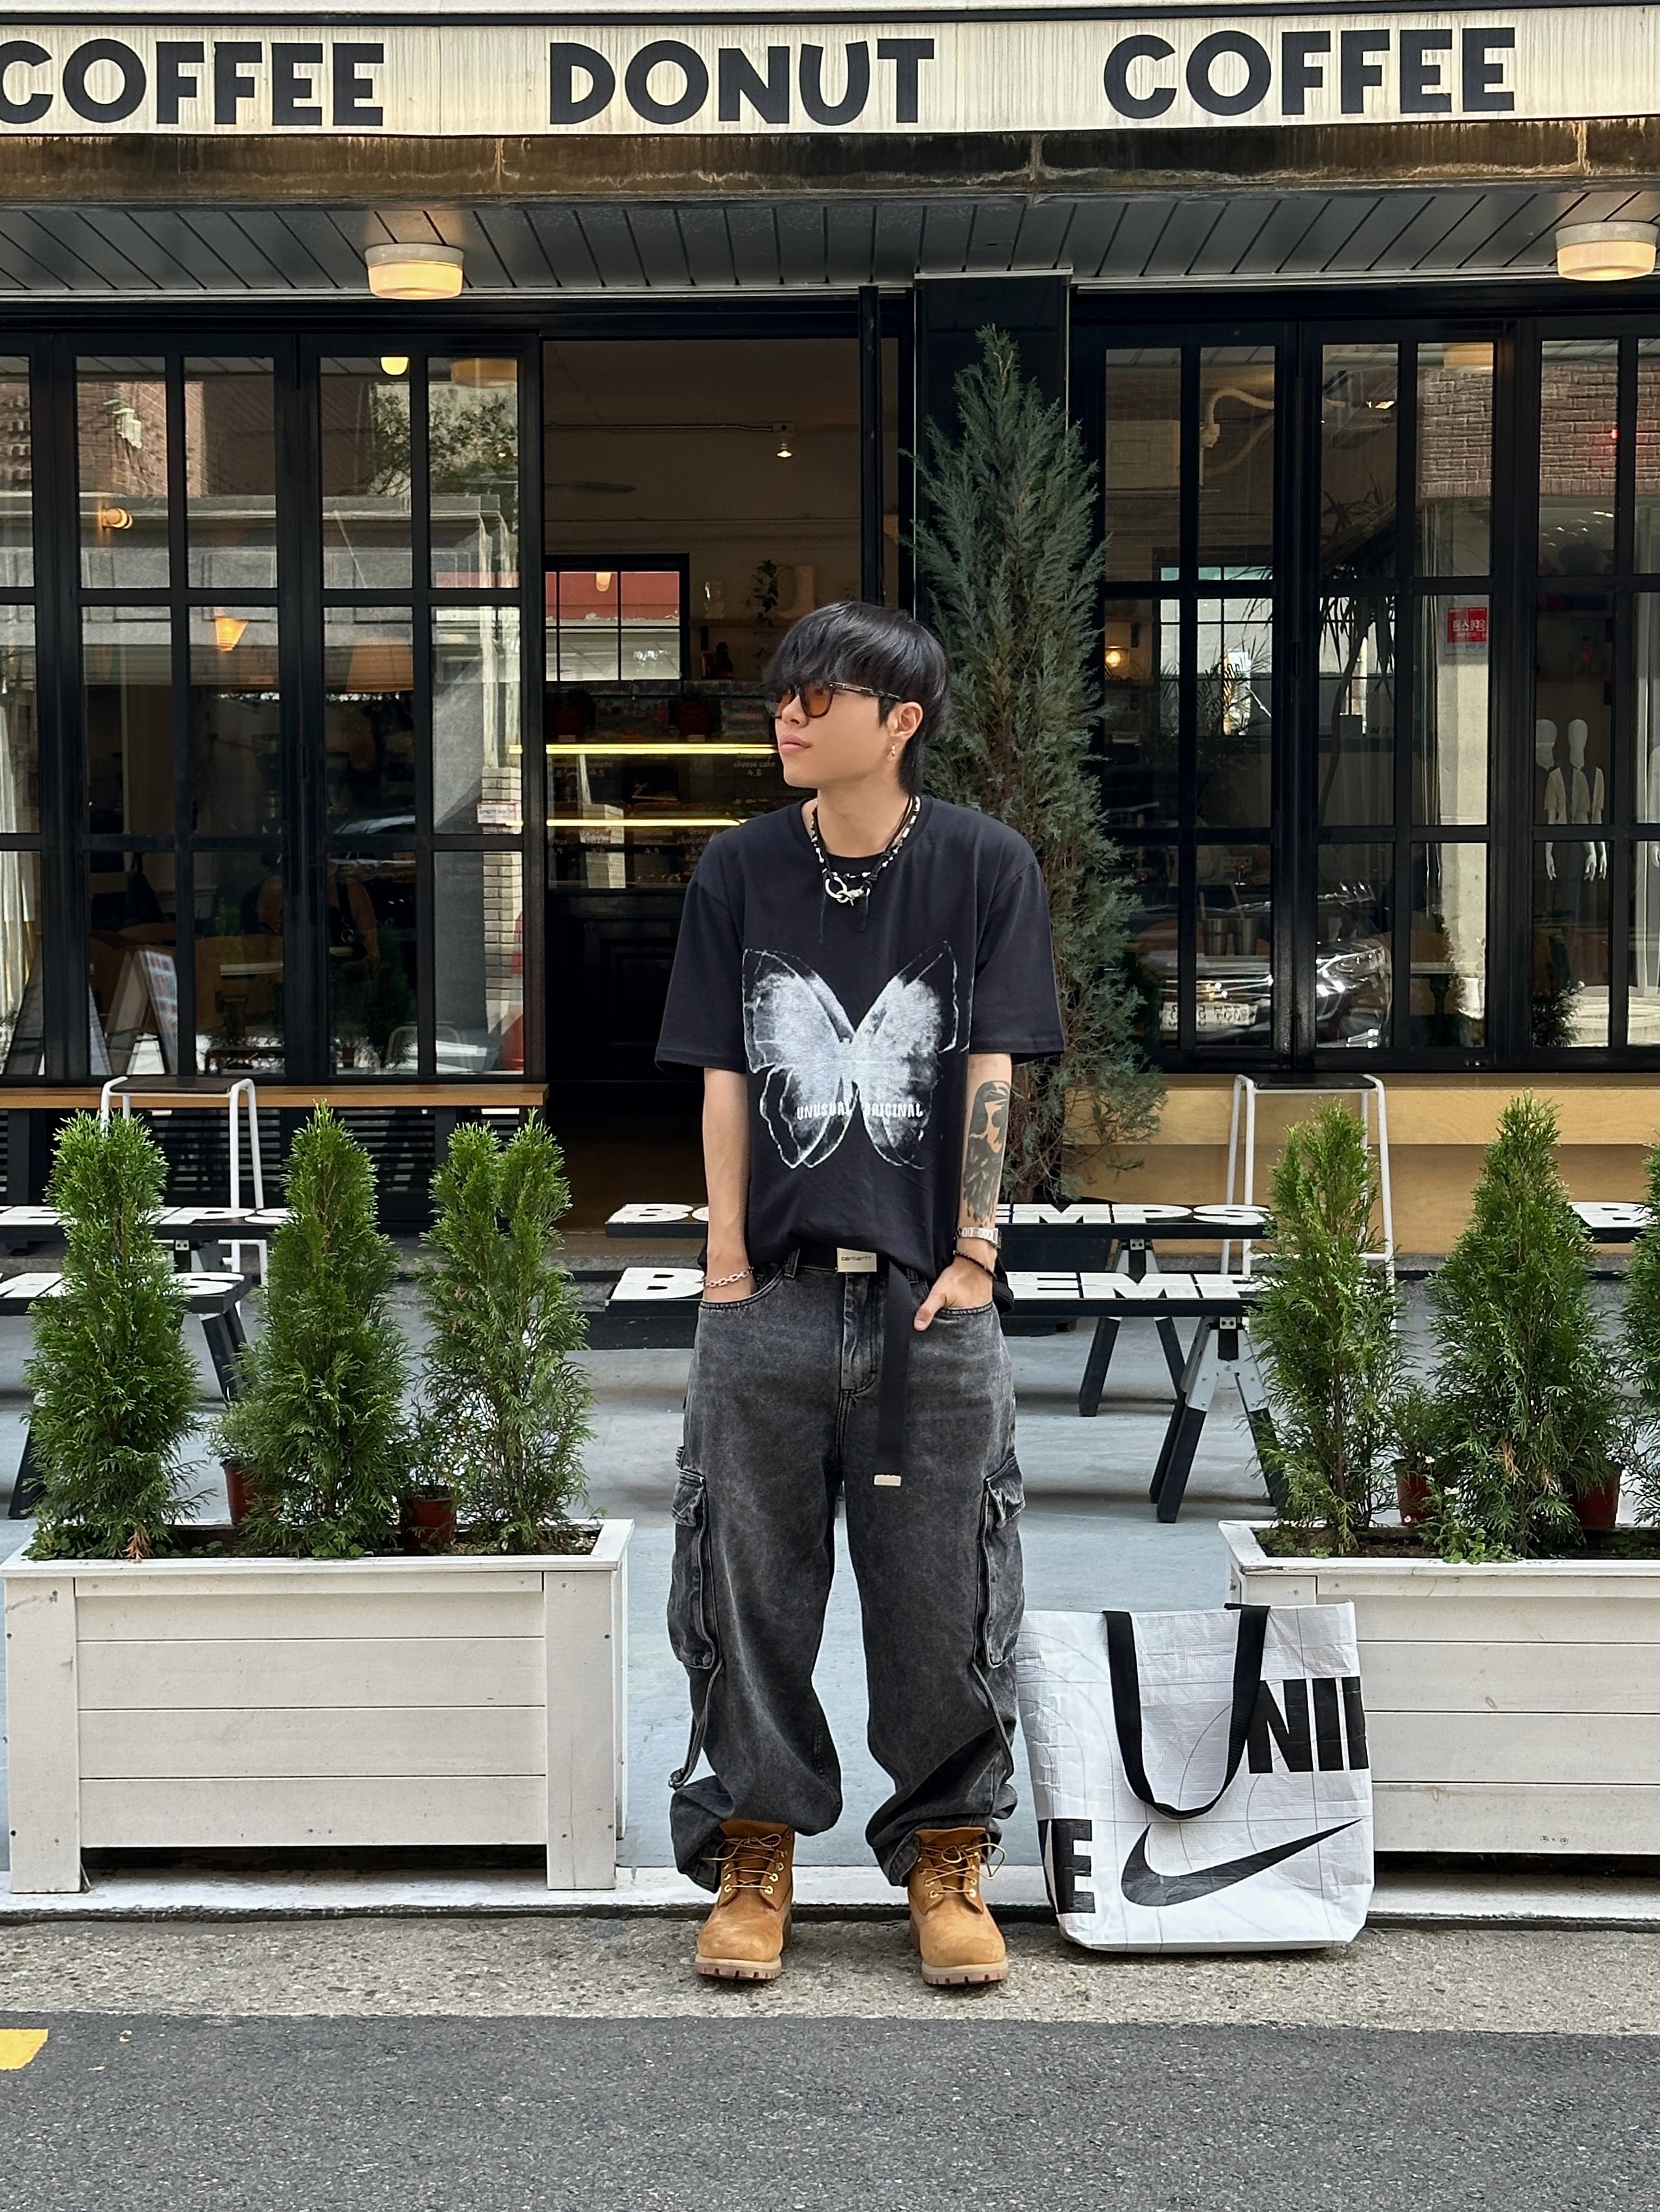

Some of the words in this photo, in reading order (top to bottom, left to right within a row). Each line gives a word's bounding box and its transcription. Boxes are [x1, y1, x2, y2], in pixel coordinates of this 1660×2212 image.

[0, 38, 384, 126] COFFEE
[550, 38, 934, 126] DONUT
[1103, 27, 1515, 119] COFFEE
